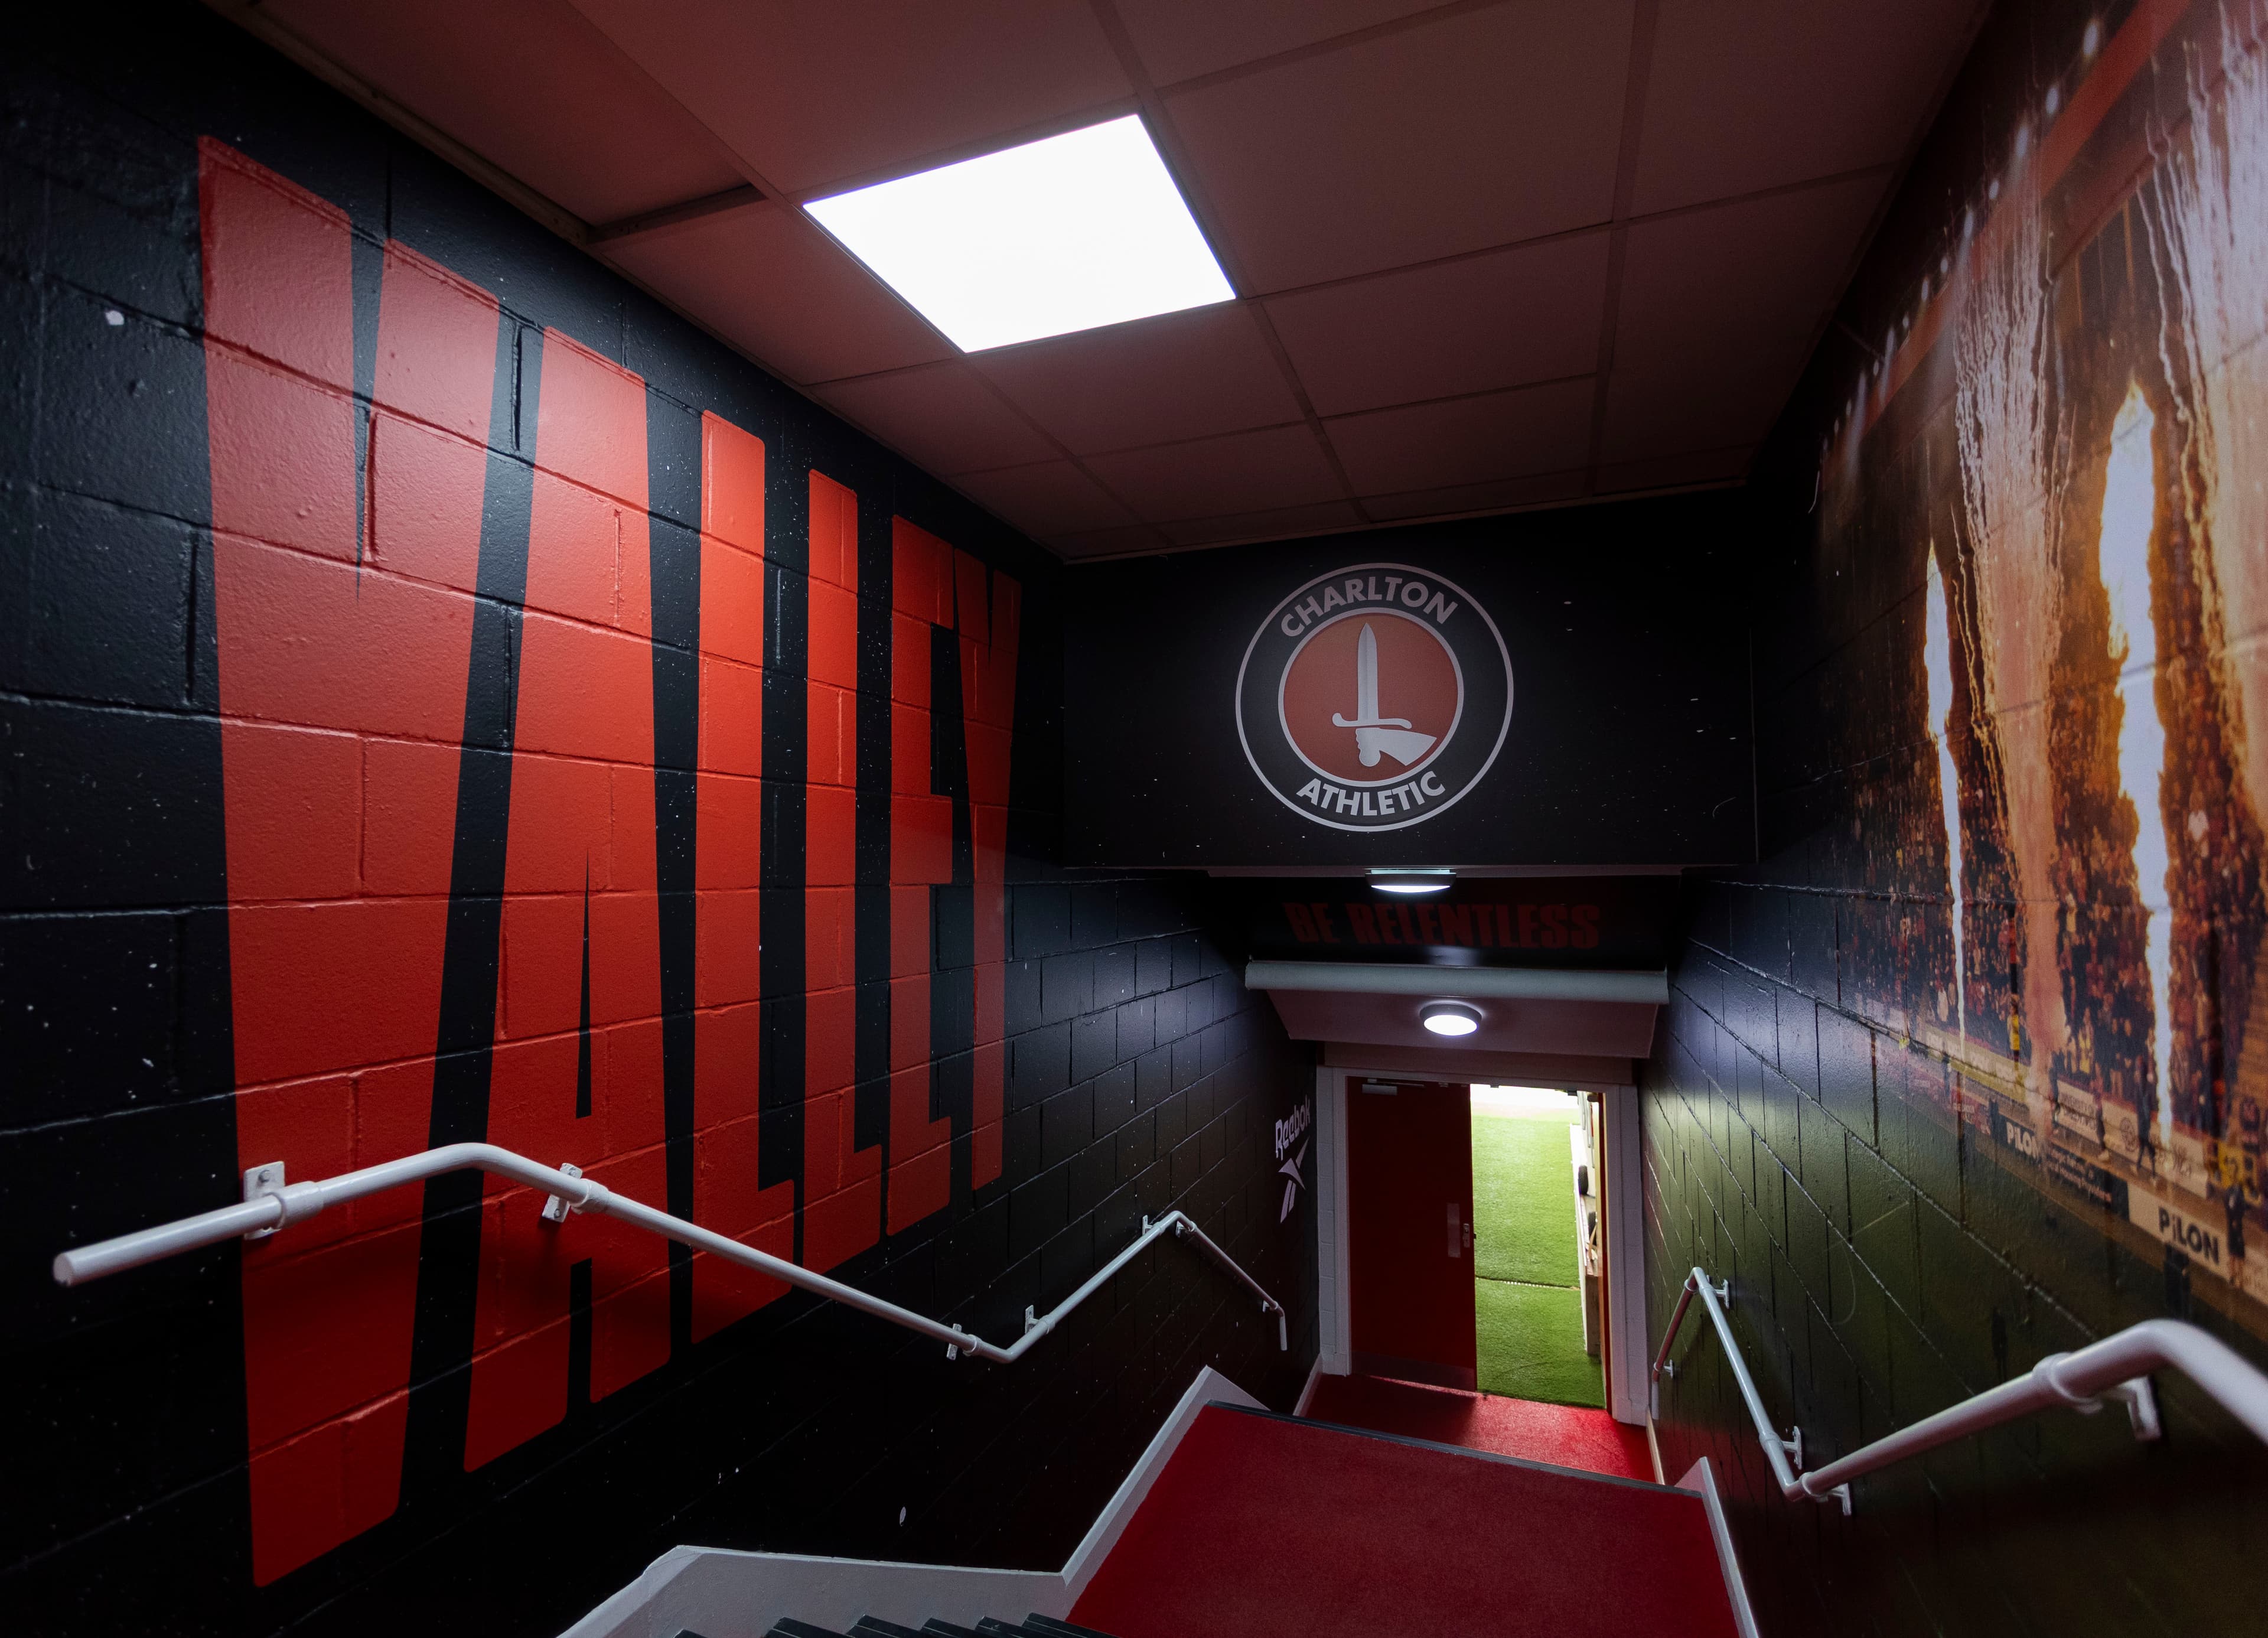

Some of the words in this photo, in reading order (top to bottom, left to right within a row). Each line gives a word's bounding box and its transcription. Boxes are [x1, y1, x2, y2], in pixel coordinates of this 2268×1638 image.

[1280, 576, 1458, 637] CHARLTON
[1296, 771, 1445, 816] ATHLETIC
[198, 135, 1021, 1587] VALLEY
[1282, 902, 1341, 944] BE
[1344, 902, 1602, 949] RELENTLESS
[1276, 1094, 1310, 1161] Reebok
